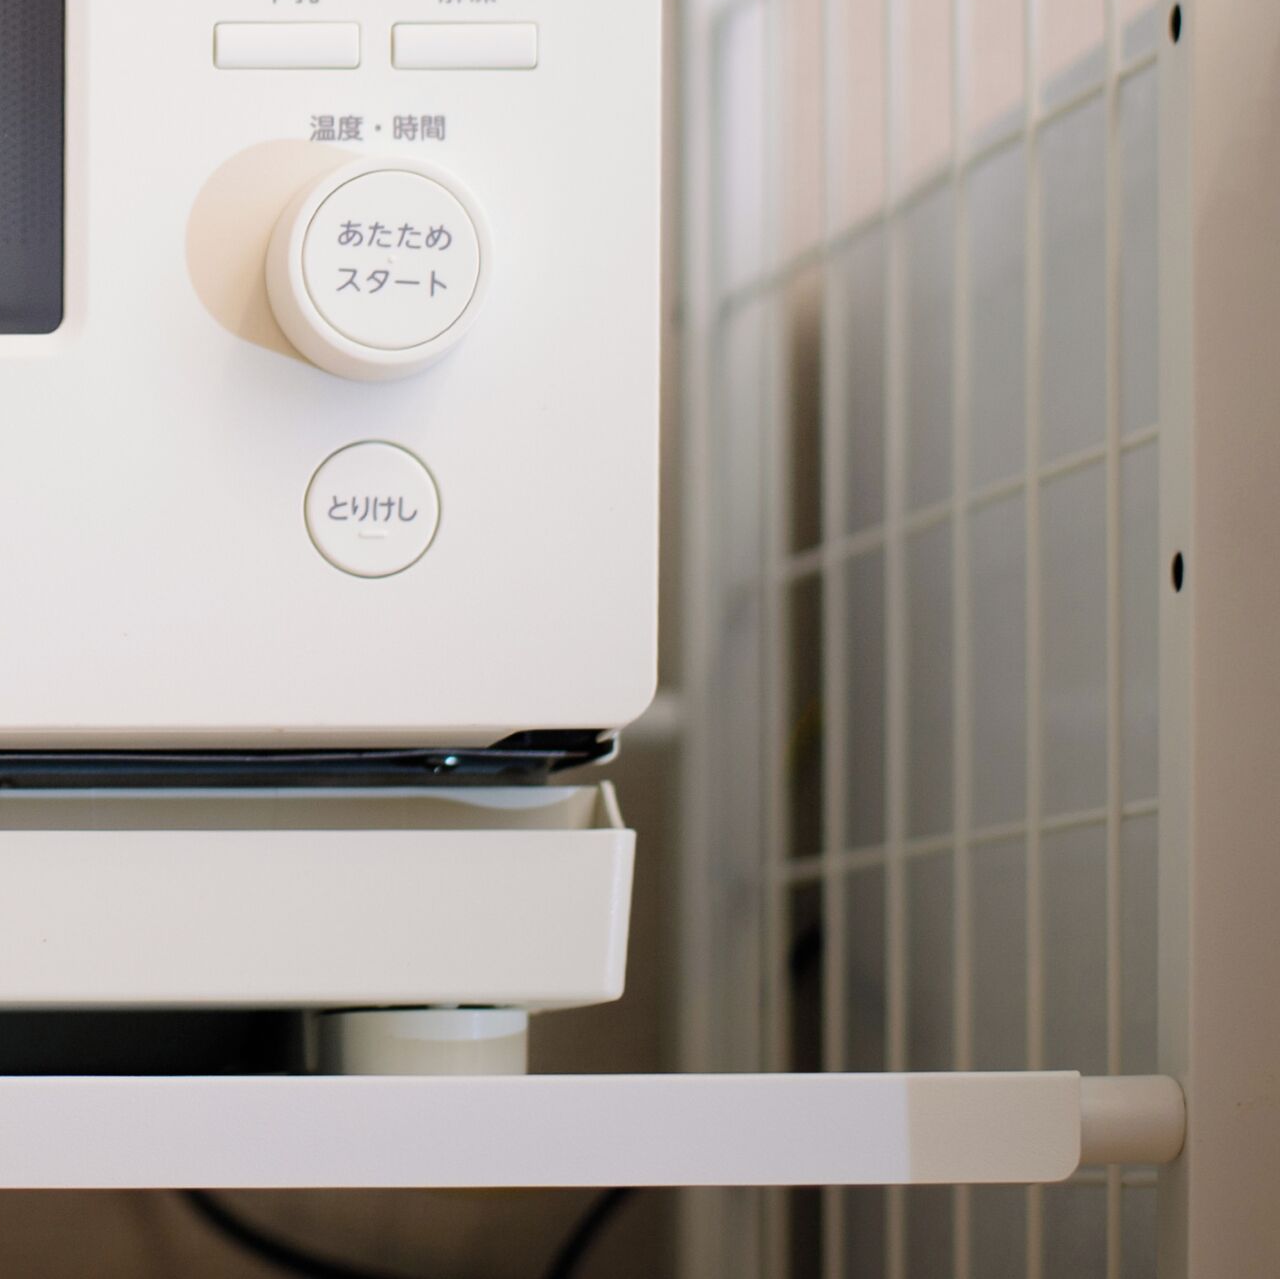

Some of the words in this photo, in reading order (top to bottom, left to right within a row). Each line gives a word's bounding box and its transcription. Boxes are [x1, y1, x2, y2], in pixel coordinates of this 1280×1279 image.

[309, 113, 447, 142] 温度・時間
[337, 220, 453, 252] あたため
[336, 268, 448, 298] スタート
[327, 494, 419, 523] とりけし
